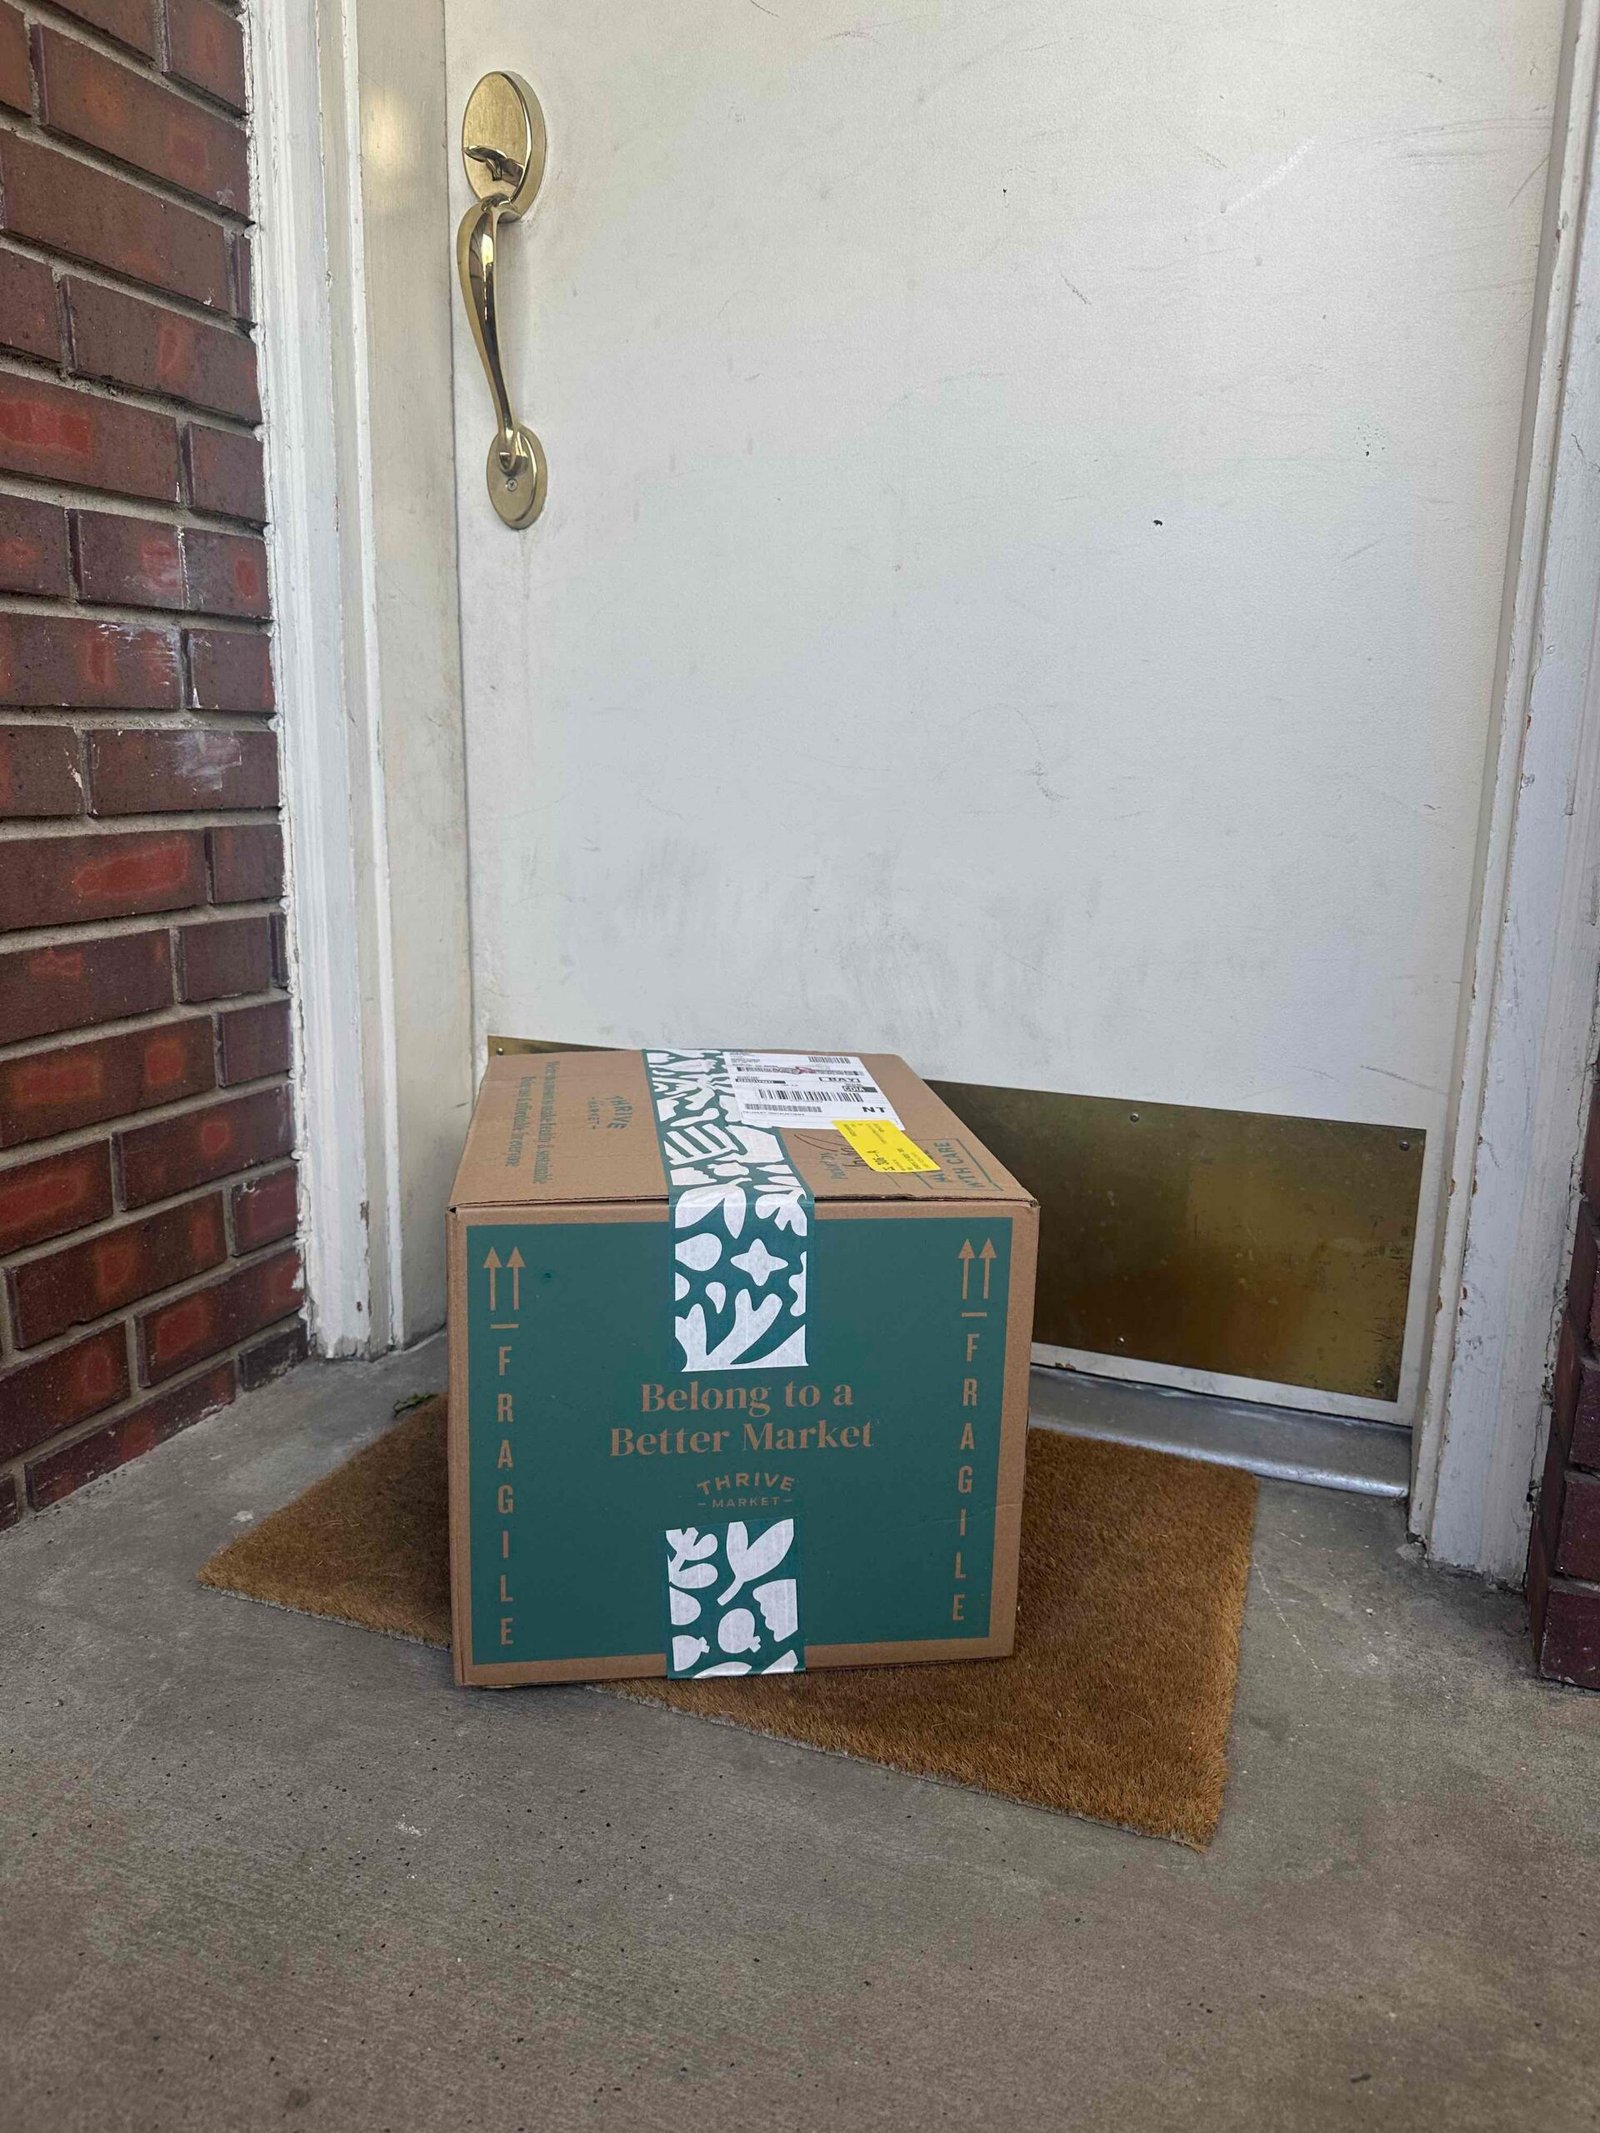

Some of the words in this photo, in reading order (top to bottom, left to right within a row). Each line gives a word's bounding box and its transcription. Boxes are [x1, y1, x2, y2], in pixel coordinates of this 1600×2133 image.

[602, 1096, 633, 1129] THRIVE
[933, 1141, 962, 1165] CARE
[641, 1380, 772, 1418] Belong
[784, 1380, 821, 1408] to
[833, 1383, 854, 1406] a
[610, 1427, 730, 1457] Better
[742, 1420, 875, 1451] Market
[696, 1471, 796, 1496] THRIVE
[952, 1333, 980, 1621] FRAGILE
[497, 1345, 514, 1646] FRAGILE
[712, 1496, 781, 1508] MARKET
